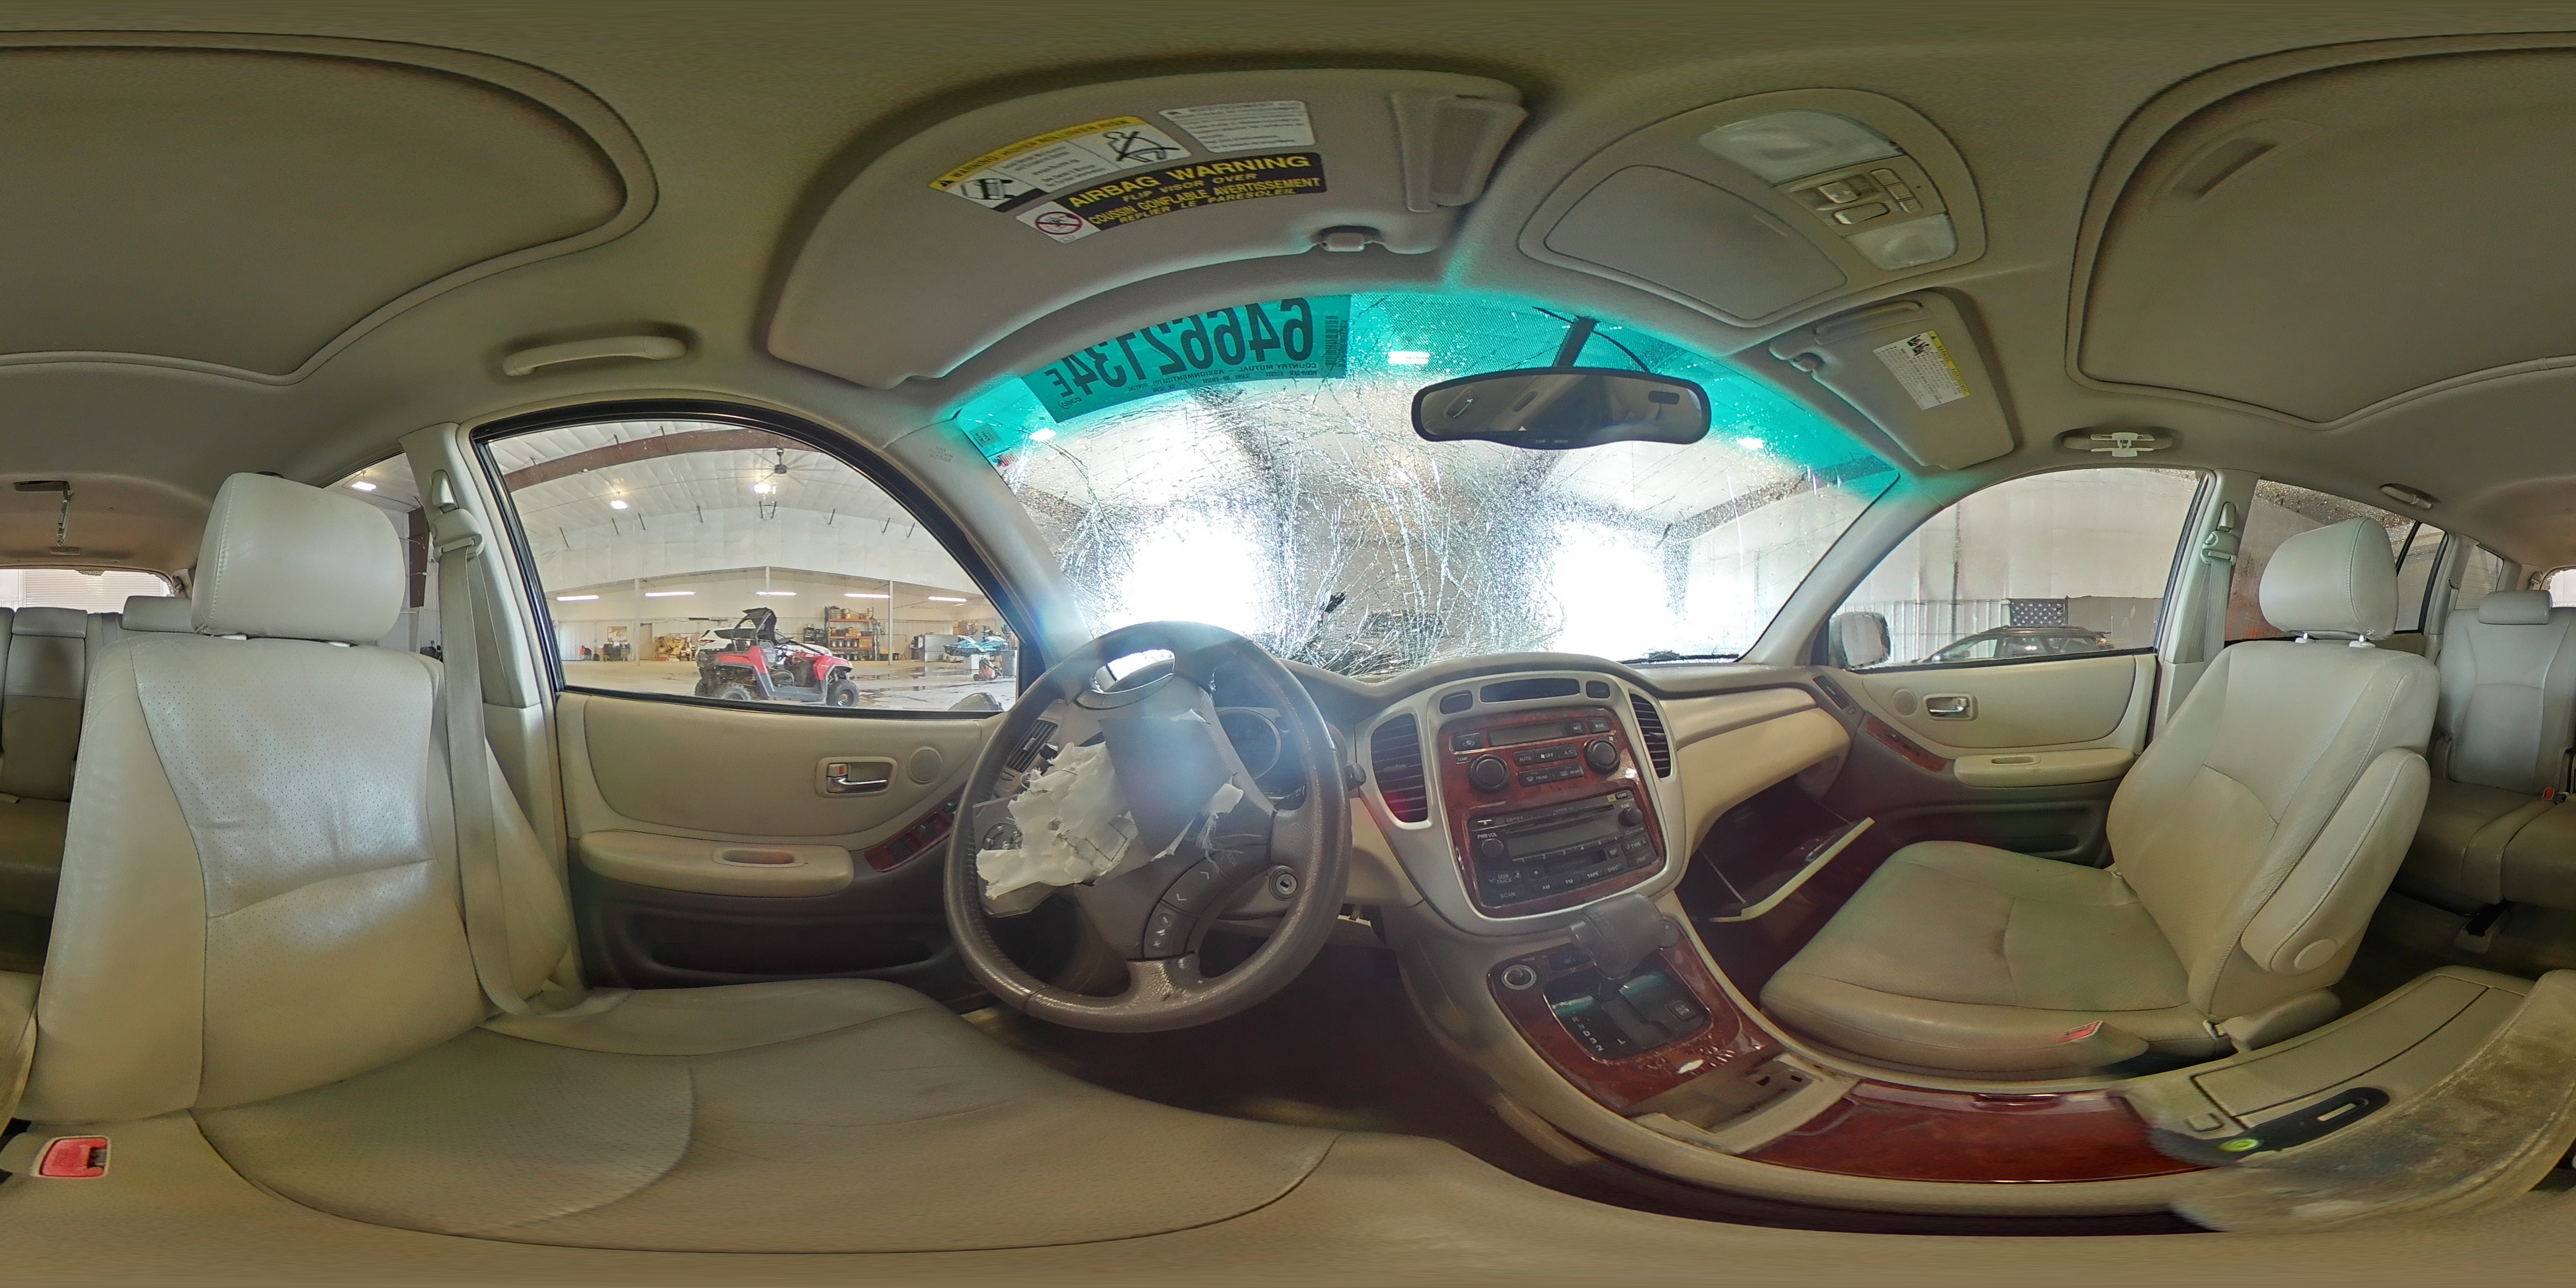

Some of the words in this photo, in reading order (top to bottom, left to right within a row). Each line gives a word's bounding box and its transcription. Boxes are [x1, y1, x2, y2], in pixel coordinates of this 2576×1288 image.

[1069, 176, 1162, 207] AIRBAG
[1164, 156, 1311, 180] WARNING
[1122, 191, 1153, 202] FLIP
[1158, 180, 1205, 193] VISOR
[1211, 173, 1258, 184] OVER
[1088, 205, 1138, 224] COUSSIN
[1137, 189, 1211, 210] GONFLABLE
[1213, 178, 1321, 196] AVERTISSEMENT
[1118, 206, 1172, 224] REPLIER
[1587, 871, 1599, 879] TAPE
